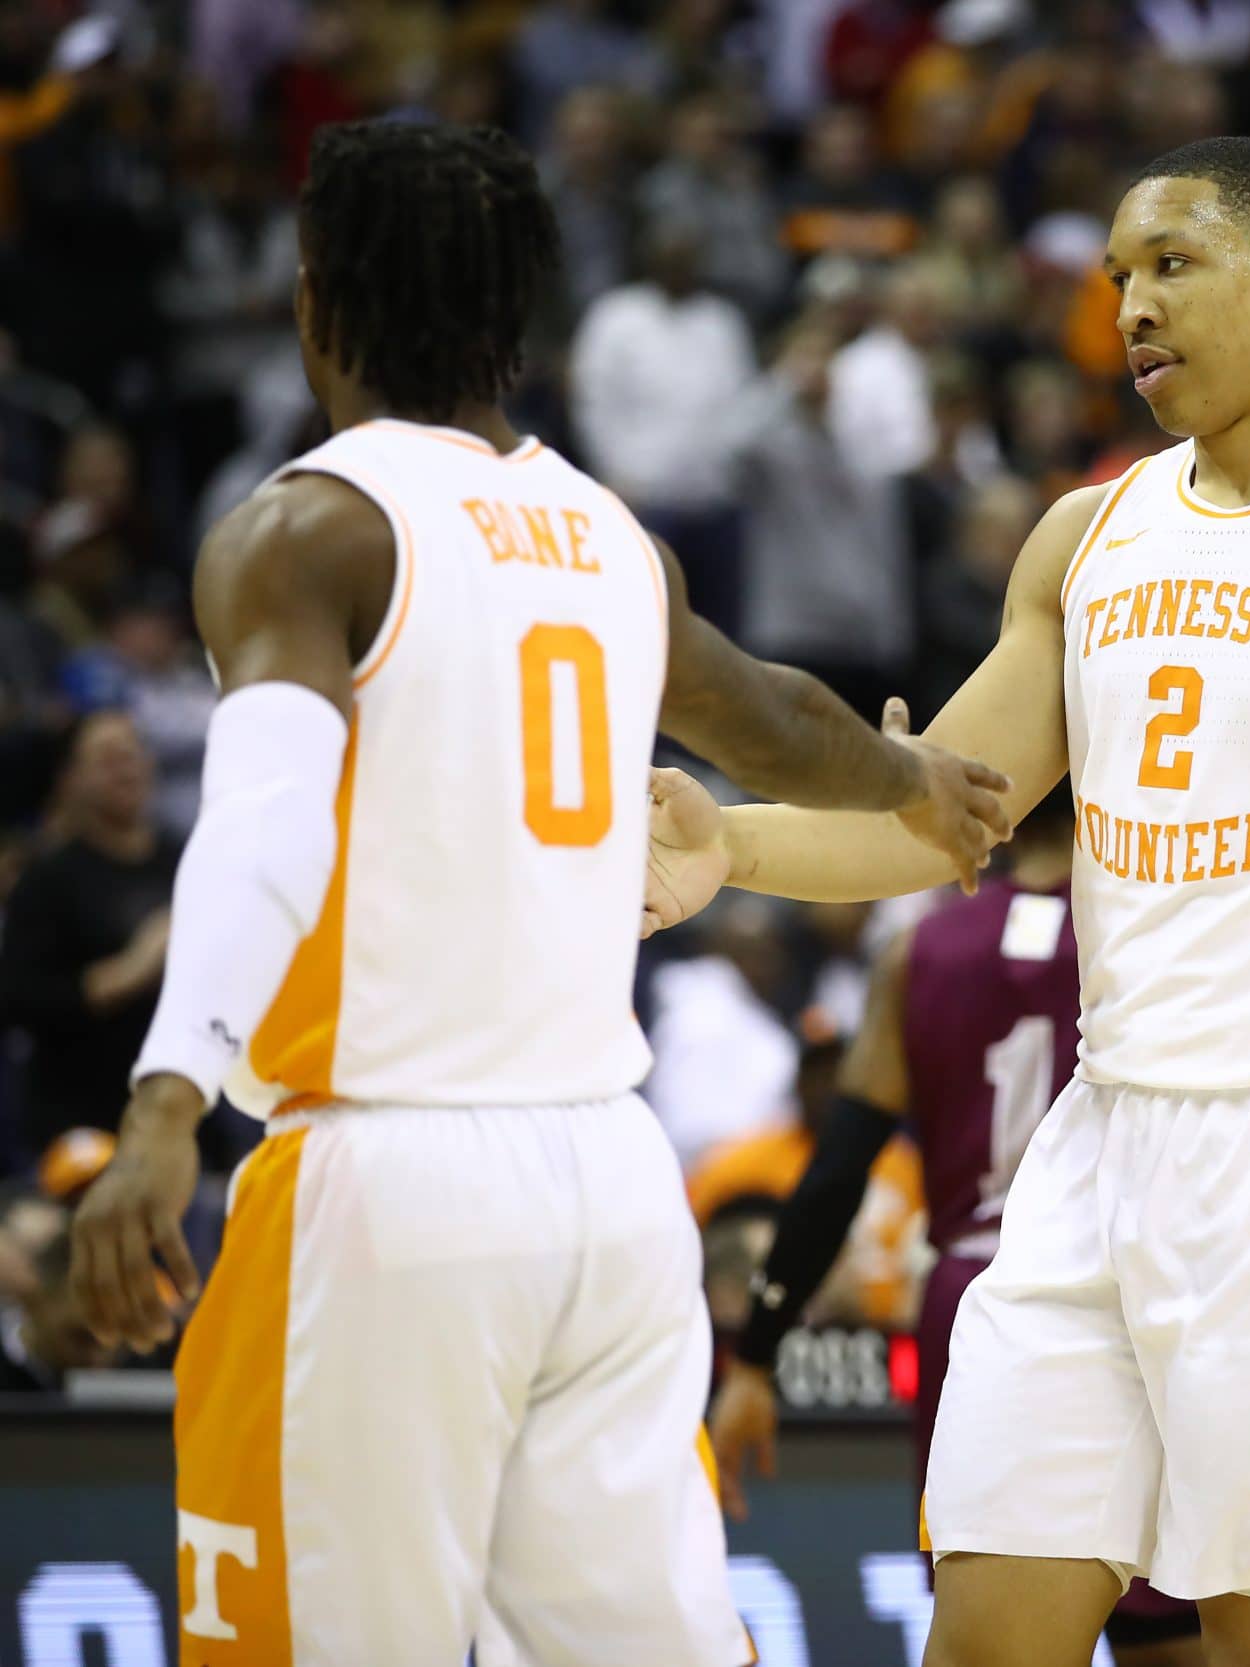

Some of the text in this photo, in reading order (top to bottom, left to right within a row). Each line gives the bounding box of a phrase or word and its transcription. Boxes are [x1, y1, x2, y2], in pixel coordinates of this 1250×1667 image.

[462, 498, 601, 574] BONE
[518, 622, 612, 848] 0
[1137, 664, 1204, 791] 2
[976, 1014, 1055, 1212] 1
[178, 1509, 258, 1640] T
